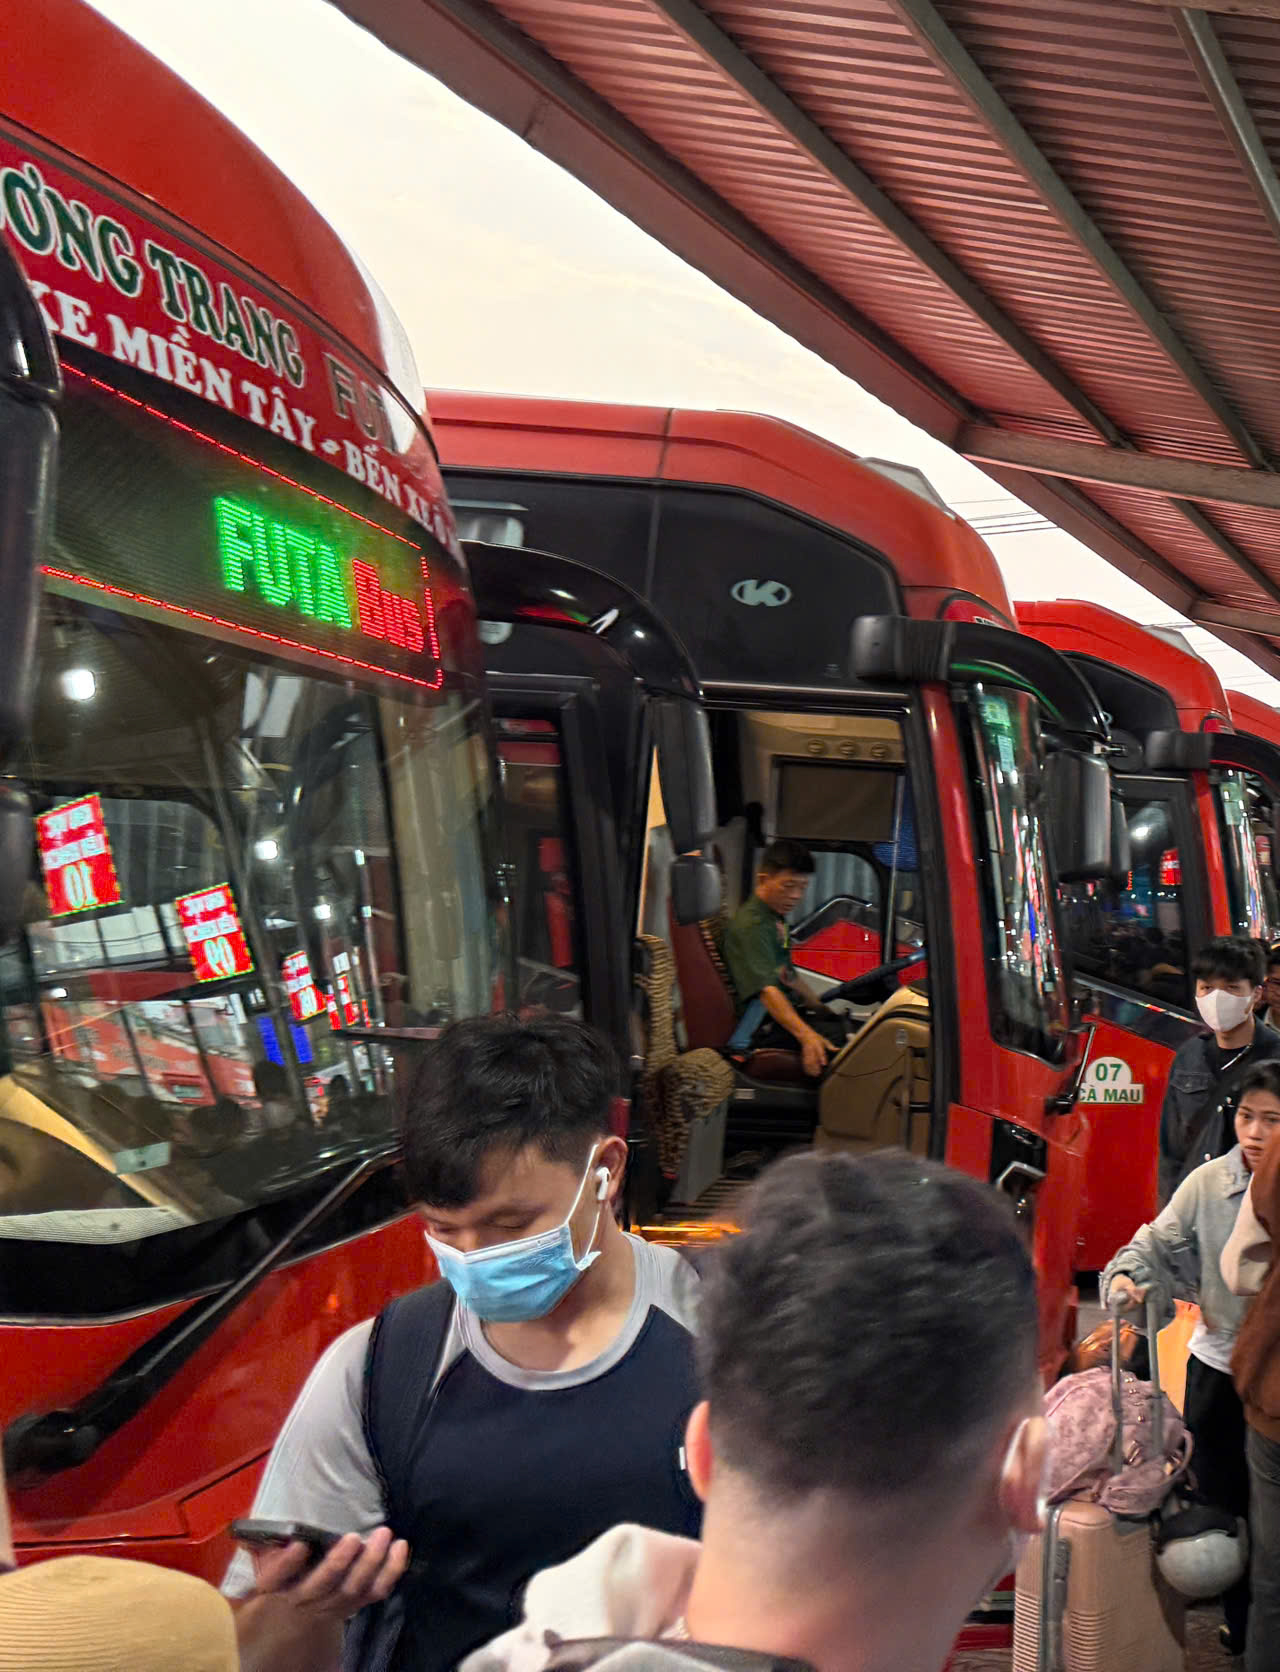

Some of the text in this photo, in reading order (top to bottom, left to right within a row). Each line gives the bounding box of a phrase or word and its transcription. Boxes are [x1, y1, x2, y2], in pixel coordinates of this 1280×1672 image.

[145, 238, 306, 389] TRANG
[106, 313, 235, 405] MIỀN
[240, 381, 317, 452] TÂY
[343, 439, 404, 507] BẾN
[215, 496, 352, 630] FUTA
[1095, 1063, 1123, 1081] 07
[1103, 1088, 1142, 1102] MAU
